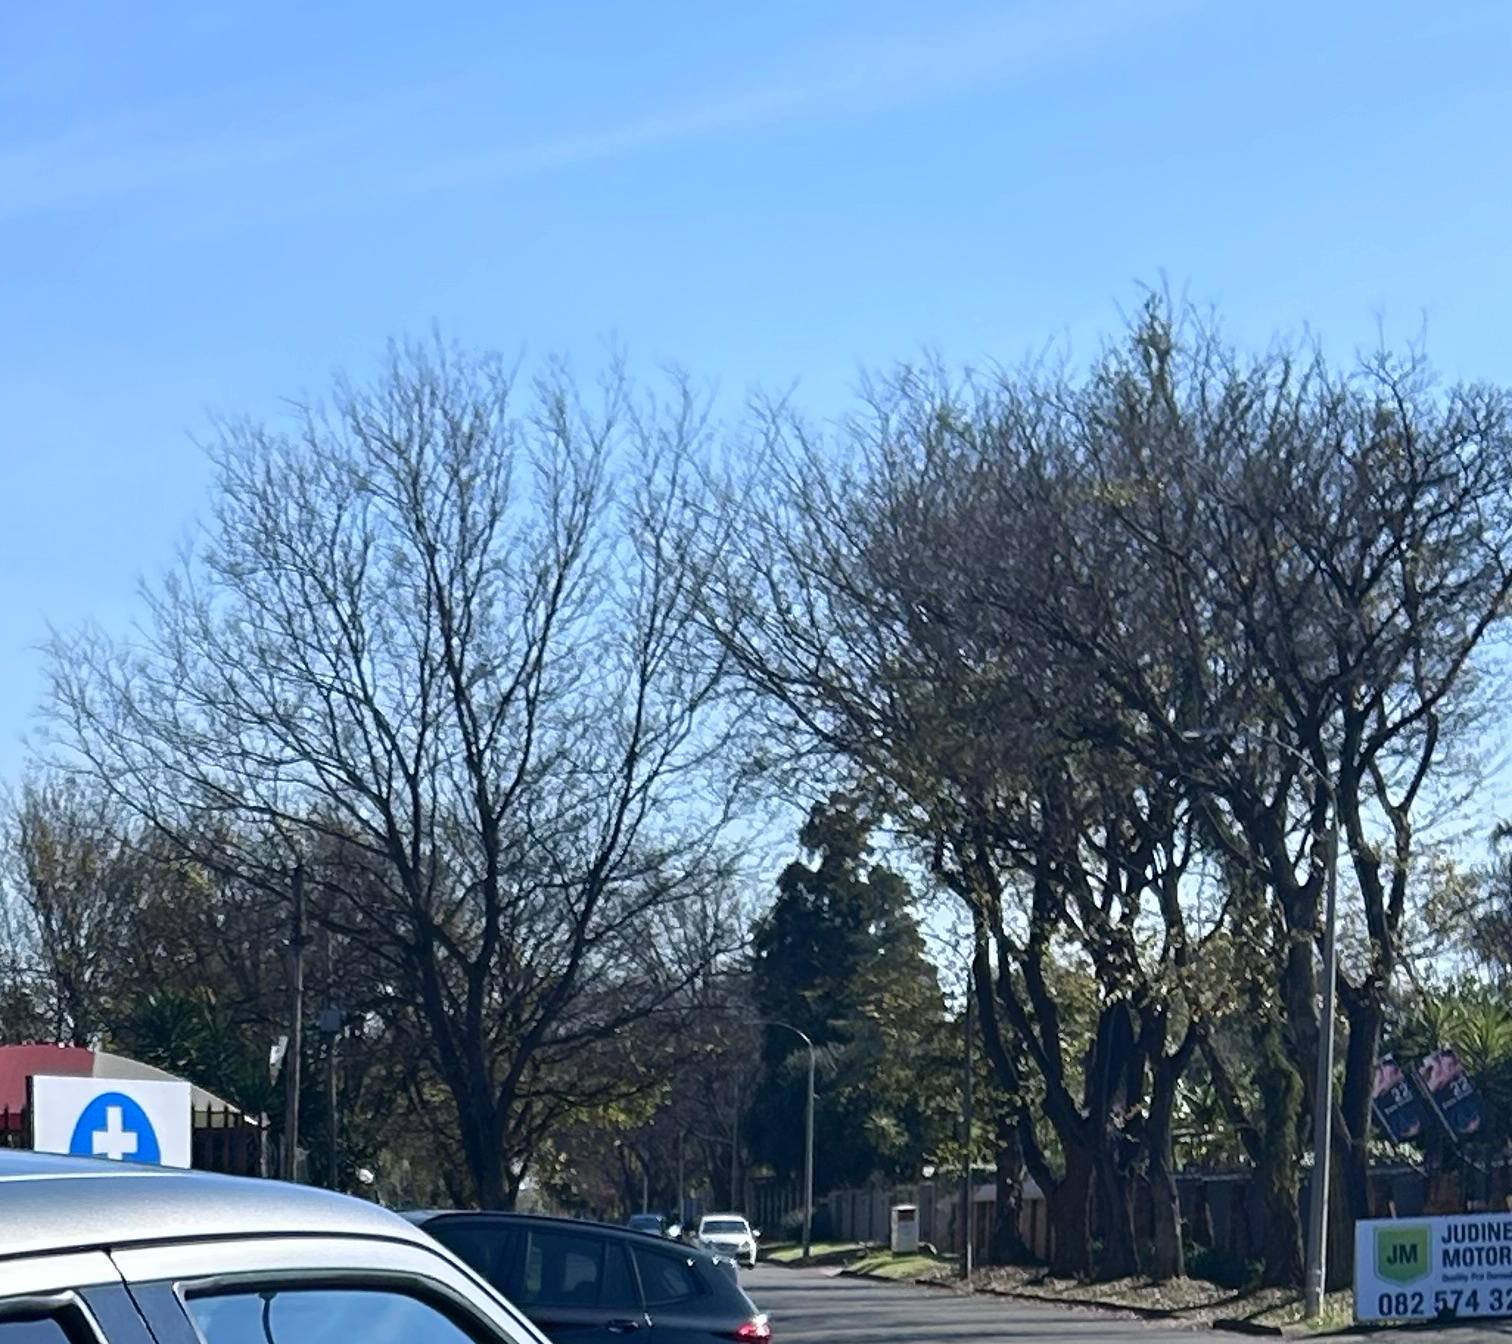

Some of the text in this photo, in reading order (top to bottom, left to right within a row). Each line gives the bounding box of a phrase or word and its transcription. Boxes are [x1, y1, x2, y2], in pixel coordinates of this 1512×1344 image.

[1441, 1222, 1512, 1244] JUDINE
[1386, 1243, 1419, 1264] JM
[1378, 1292, 1425, 1316] 082
[1434, 1288, 1480, 1313] 574
